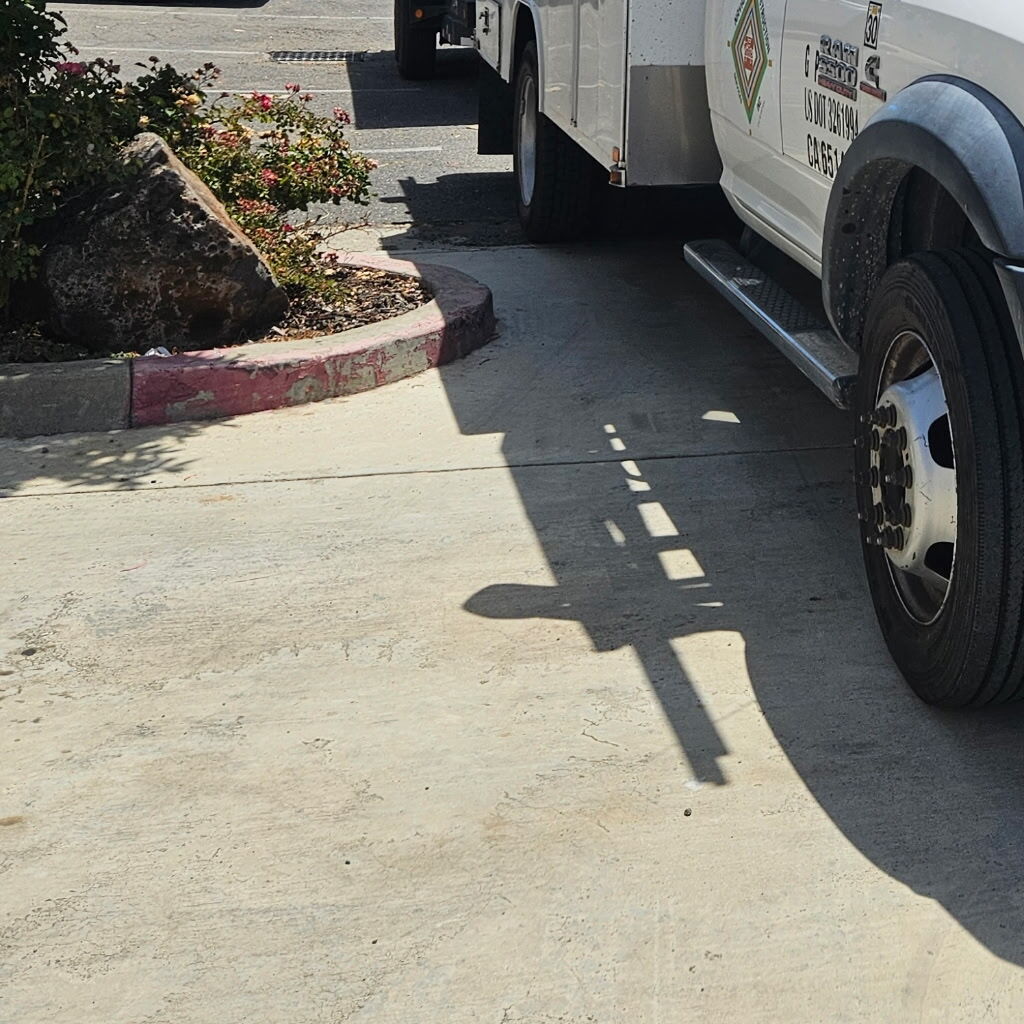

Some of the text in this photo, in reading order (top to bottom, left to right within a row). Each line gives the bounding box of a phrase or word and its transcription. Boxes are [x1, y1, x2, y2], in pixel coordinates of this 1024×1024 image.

[864, 14, 878, 45] 30
[820, 34, 859, 67] RAM
[814, 91, 827, 129] DOT
[806, 133, 844, 179] CA 651
